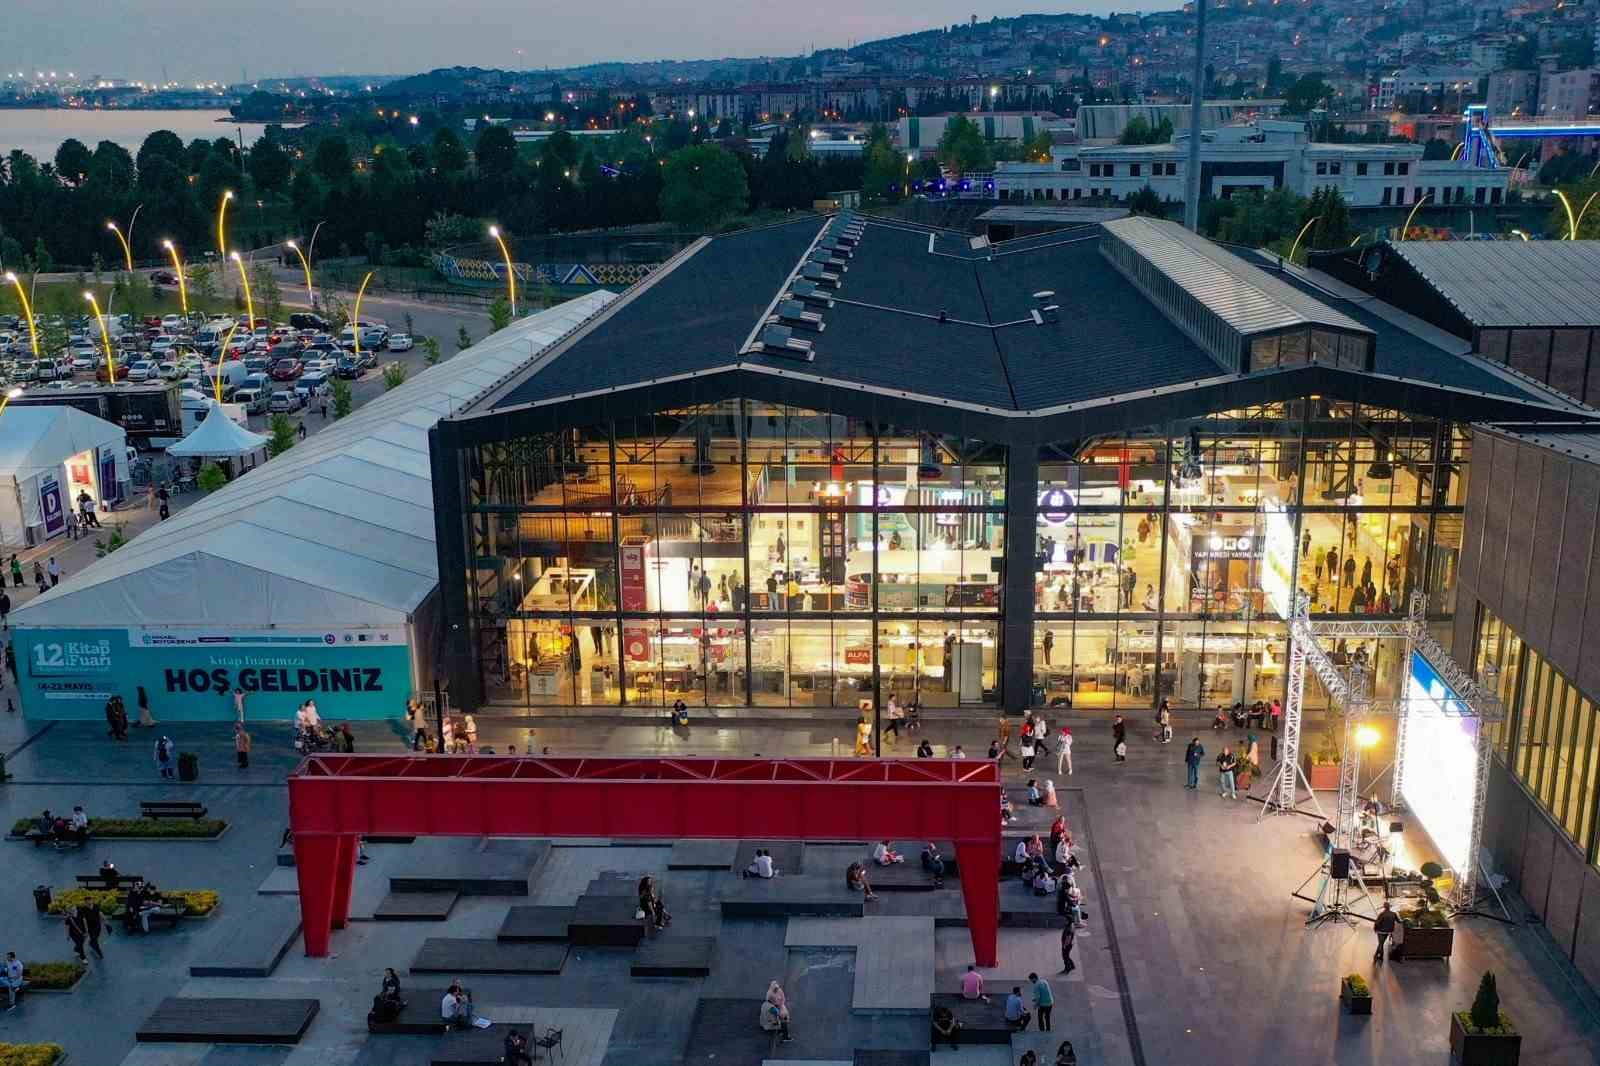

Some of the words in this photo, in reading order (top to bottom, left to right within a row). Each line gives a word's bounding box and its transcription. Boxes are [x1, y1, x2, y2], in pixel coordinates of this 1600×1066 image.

[33, 643, 64, 666] 12
[68, 641, 111, 656] Kitap
[164, 668, 230, 696] HOŞ
